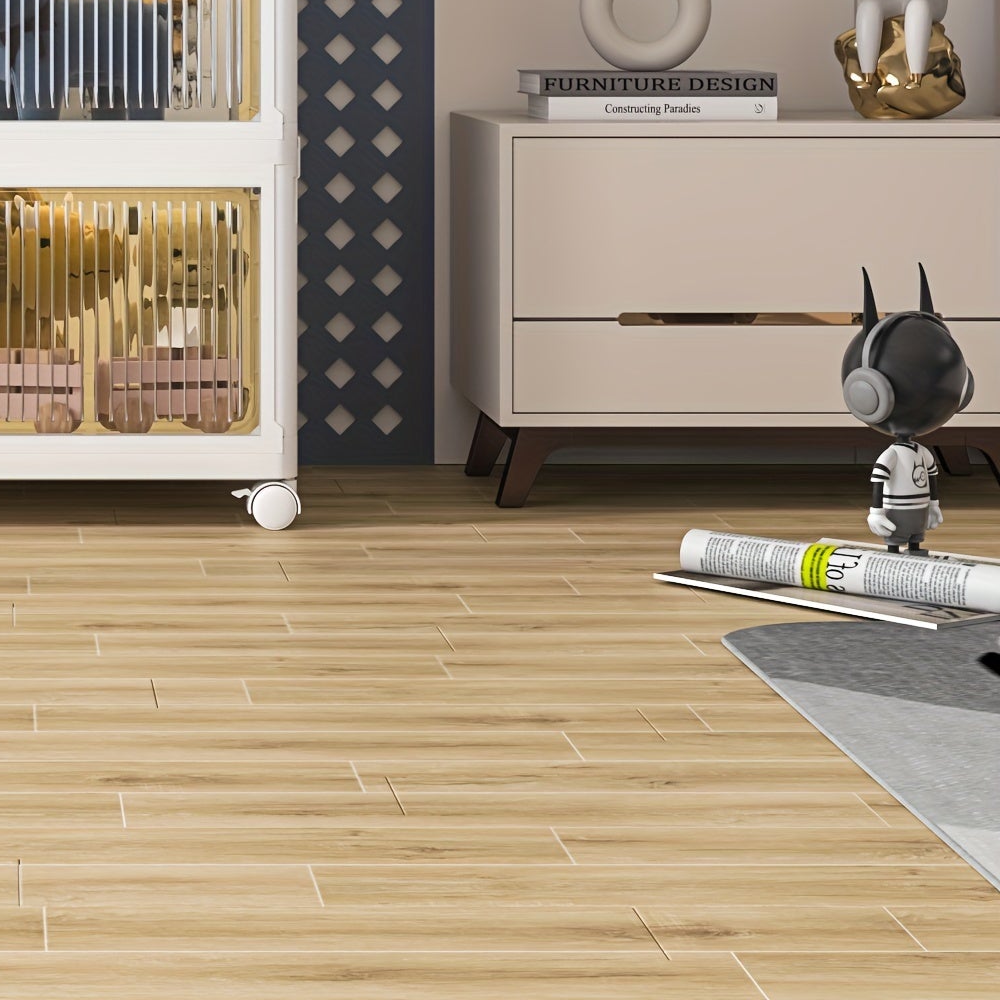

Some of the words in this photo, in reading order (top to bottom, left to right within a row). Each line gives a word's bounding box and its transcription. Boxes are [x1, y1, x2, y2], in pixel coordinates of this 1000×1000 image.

[544, 77, 681, 91] FURNITURE
[689, 77, 775, 91] DESIGN
[604, 103, 661, 115] Constructing
[664, 103, 701, 114] Paradies
